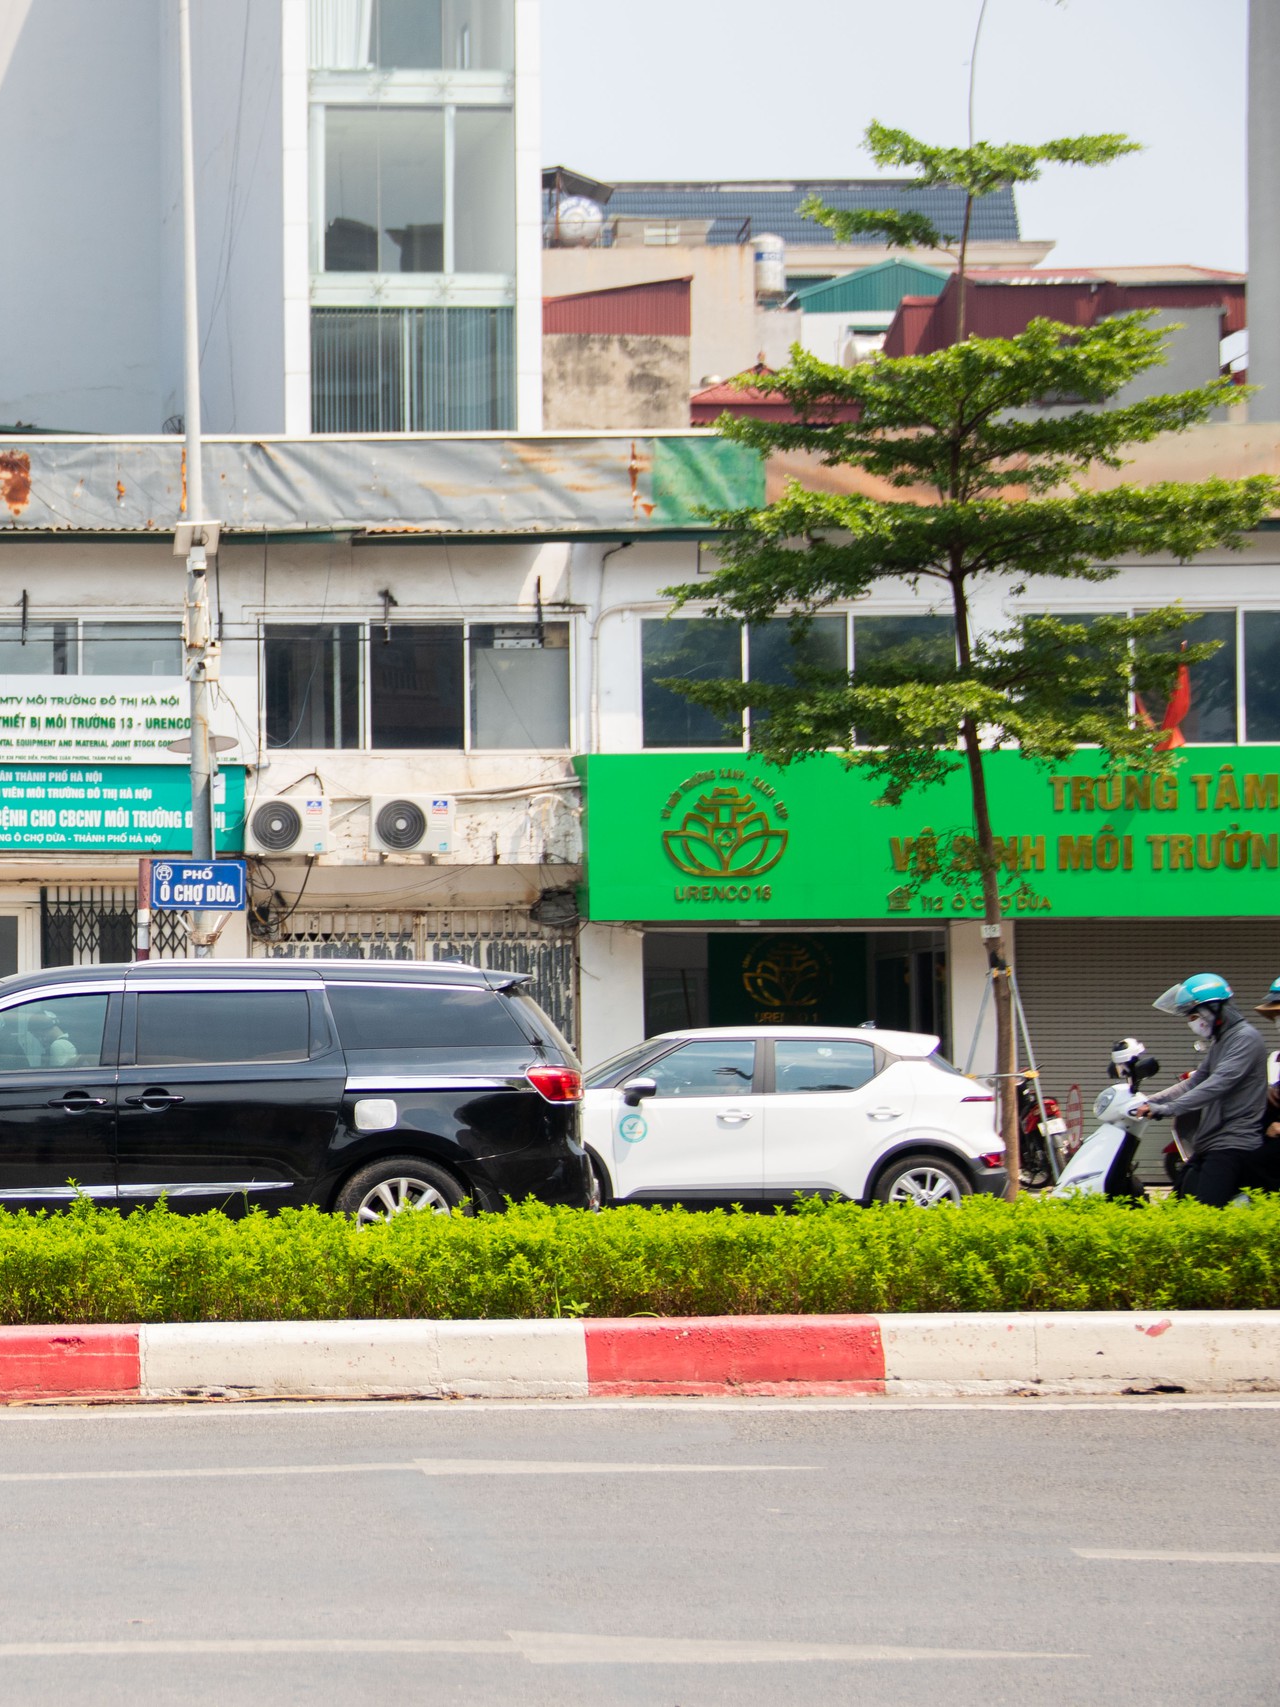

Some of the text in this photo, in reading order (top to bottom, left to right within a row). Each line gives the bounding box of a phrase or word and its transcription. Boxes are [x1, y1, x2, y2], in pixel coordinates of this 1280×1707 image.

[0, 697, 23, 705] MTV
[26, 694, 47, 705] MÔI
[50, 694, 97, 706] TRƯỜNG
[100, 695, 117, 706] ĐÔ
[120, 697, 138, 707] THỊ
[141, 695, 157, 706] HÀ
[160, 695, 180, 707] NỘI
[30, 716, 41, 731] BỊ
[45, 714, 67, 729] MÔI
[71, 713, 116, 729] TRƯỜNG
[120, 718, 134, 729] 13
[145, 718, 191, 729] URENCO
[16, 739, 56, 747] EQUIPMENT
[58, 739, 73, 747] AND
[75, 739, 109, 748] MATERIAL
[111, 740, 131, 748] JOINT
[133, 740, 155, 748] STOCK
[15, 770, 46, 782] THÀNH
[48, 769, 69, 782] PHỐ
[70, 771, 84, 782] HÀ
[85, 771, 103, 784] NỘI
[2, 786, 26, 799] VIÊN
[26, 786, 46, 799] MÔI
[47, 786, 85, 799] TRƯỜNG
[86, 787, 101, 799] ĐÔ
[102, 788, 117, 801] THỊ
[119, 787, 133, 799] HÀ
[135, 787, 152, 801] NỘI
[1048, 763, 1279, 811] TRUNG TÂM
[30, 810, 56, 827] CHO
[59, 810, 102, 828] CBCNV
[104, 806, 129, 828] MÔI
[132, 806, 183, 829] TRƯỜNG
[13, 832, 21, 842] Ô
[23, 833, 44, 844] CHỢ
[45, 833, 66, 843] DỪA
[73, 833, 105, 843] THÀNH
[107, 832, 127, 843] PHỐ
[129, 832, 143, 843] HÀ
[144, 833, 162, 845] NỘI
[951, 835, 1045, 872] SNH
[1057, 824, 1134, 871] MÔI
[1146, 823, 1280, 869] TRƯỜN
[182, 866, 213, 880] PHỐ
[160, 881, 236, 905] Ô CHỢ DỪA
[674, 885, 752, 901] URENCO
[922, 896, 944, 911] 112
[952, 893, 966, 910] Ô
